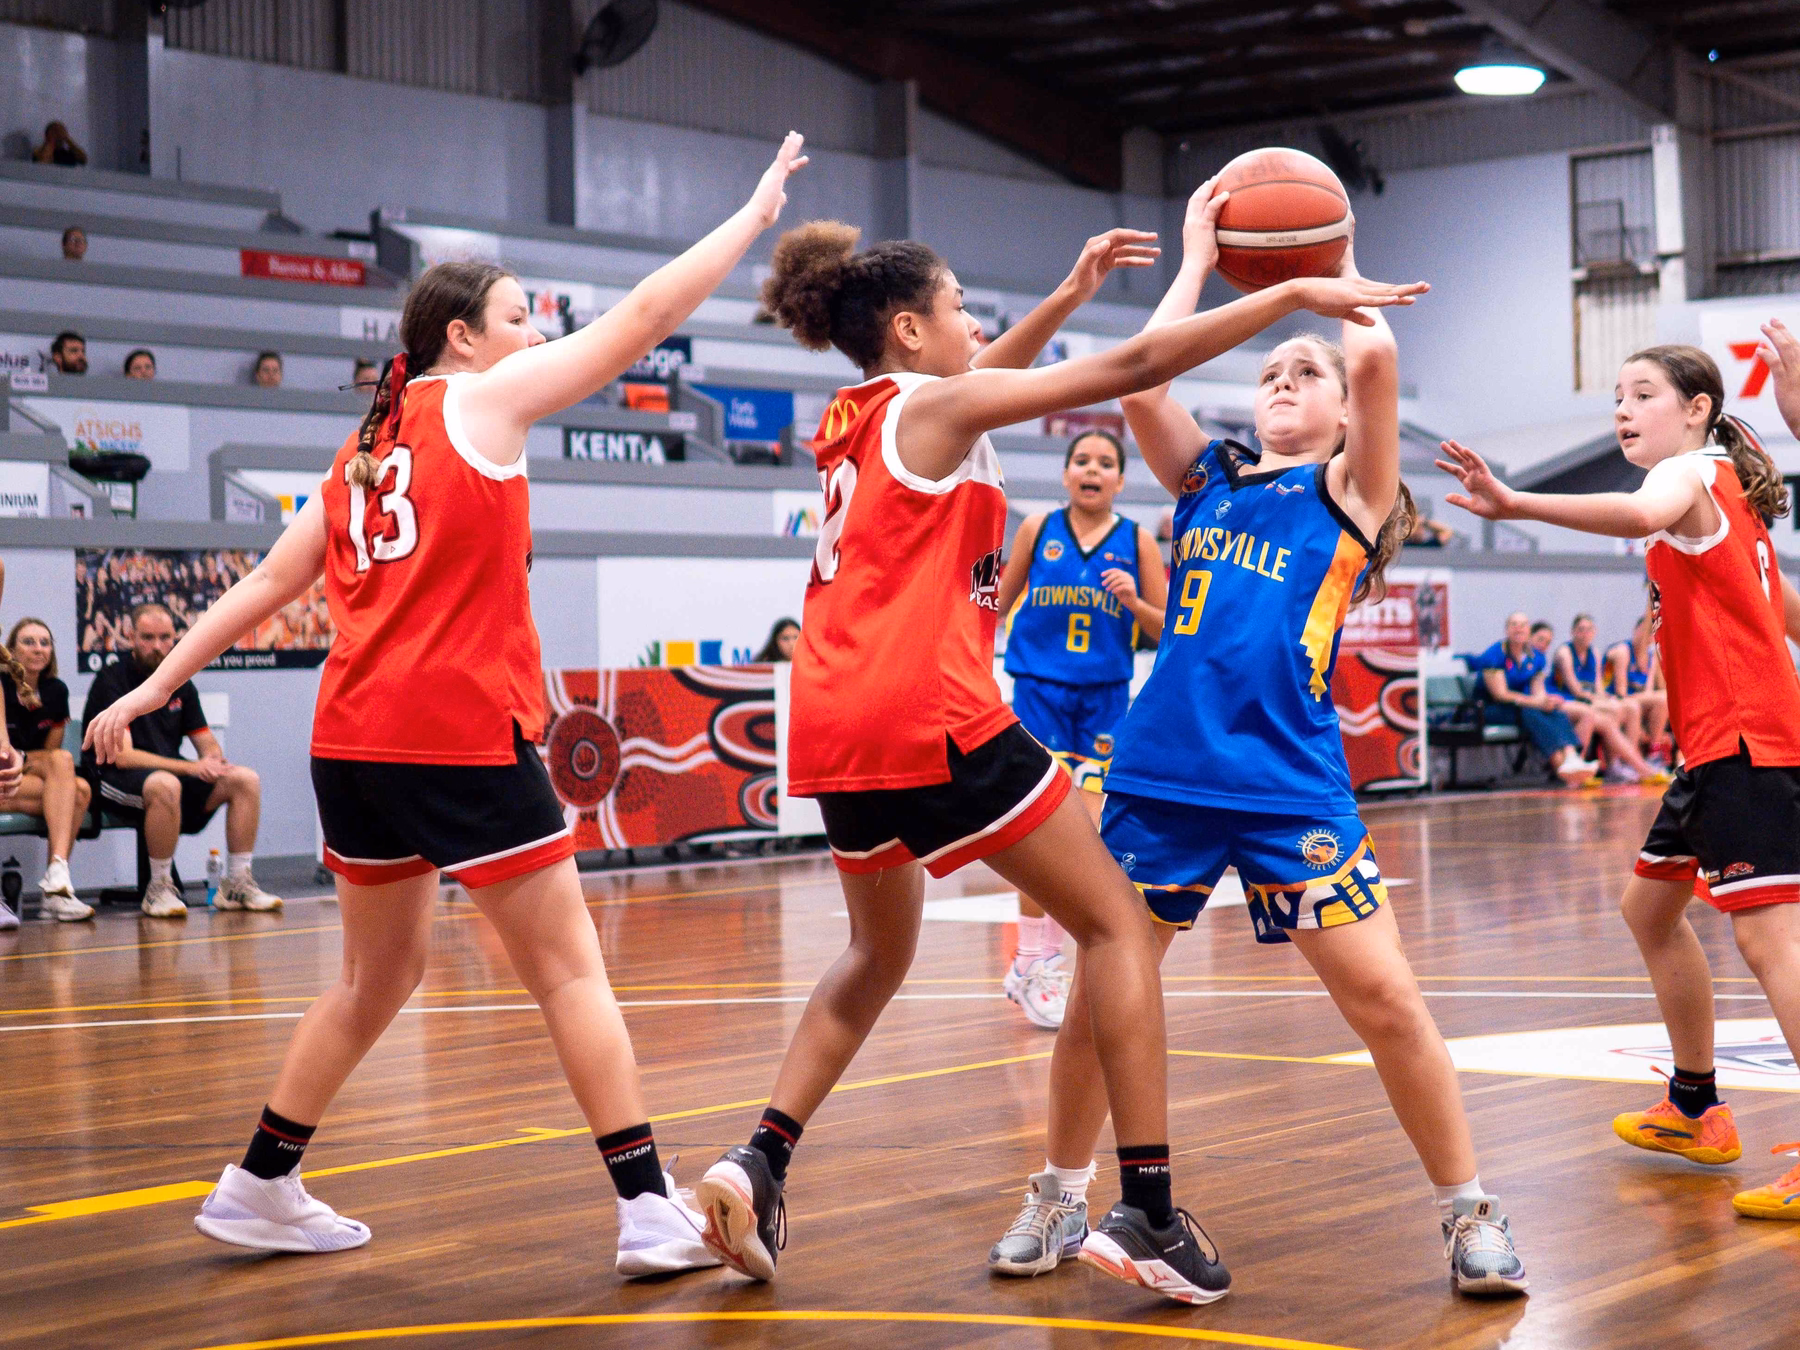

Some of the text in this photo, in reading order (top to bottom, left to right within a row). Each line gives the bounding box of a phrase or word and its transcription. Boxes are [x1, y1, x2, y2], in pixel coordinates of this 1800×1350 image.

[344, 443, 420, 573] 13
[1173, 569, 1213, 635] 9
[1066, 612, 1092, 653] 6
[608, 1144, 652, 1166] MACKAY
